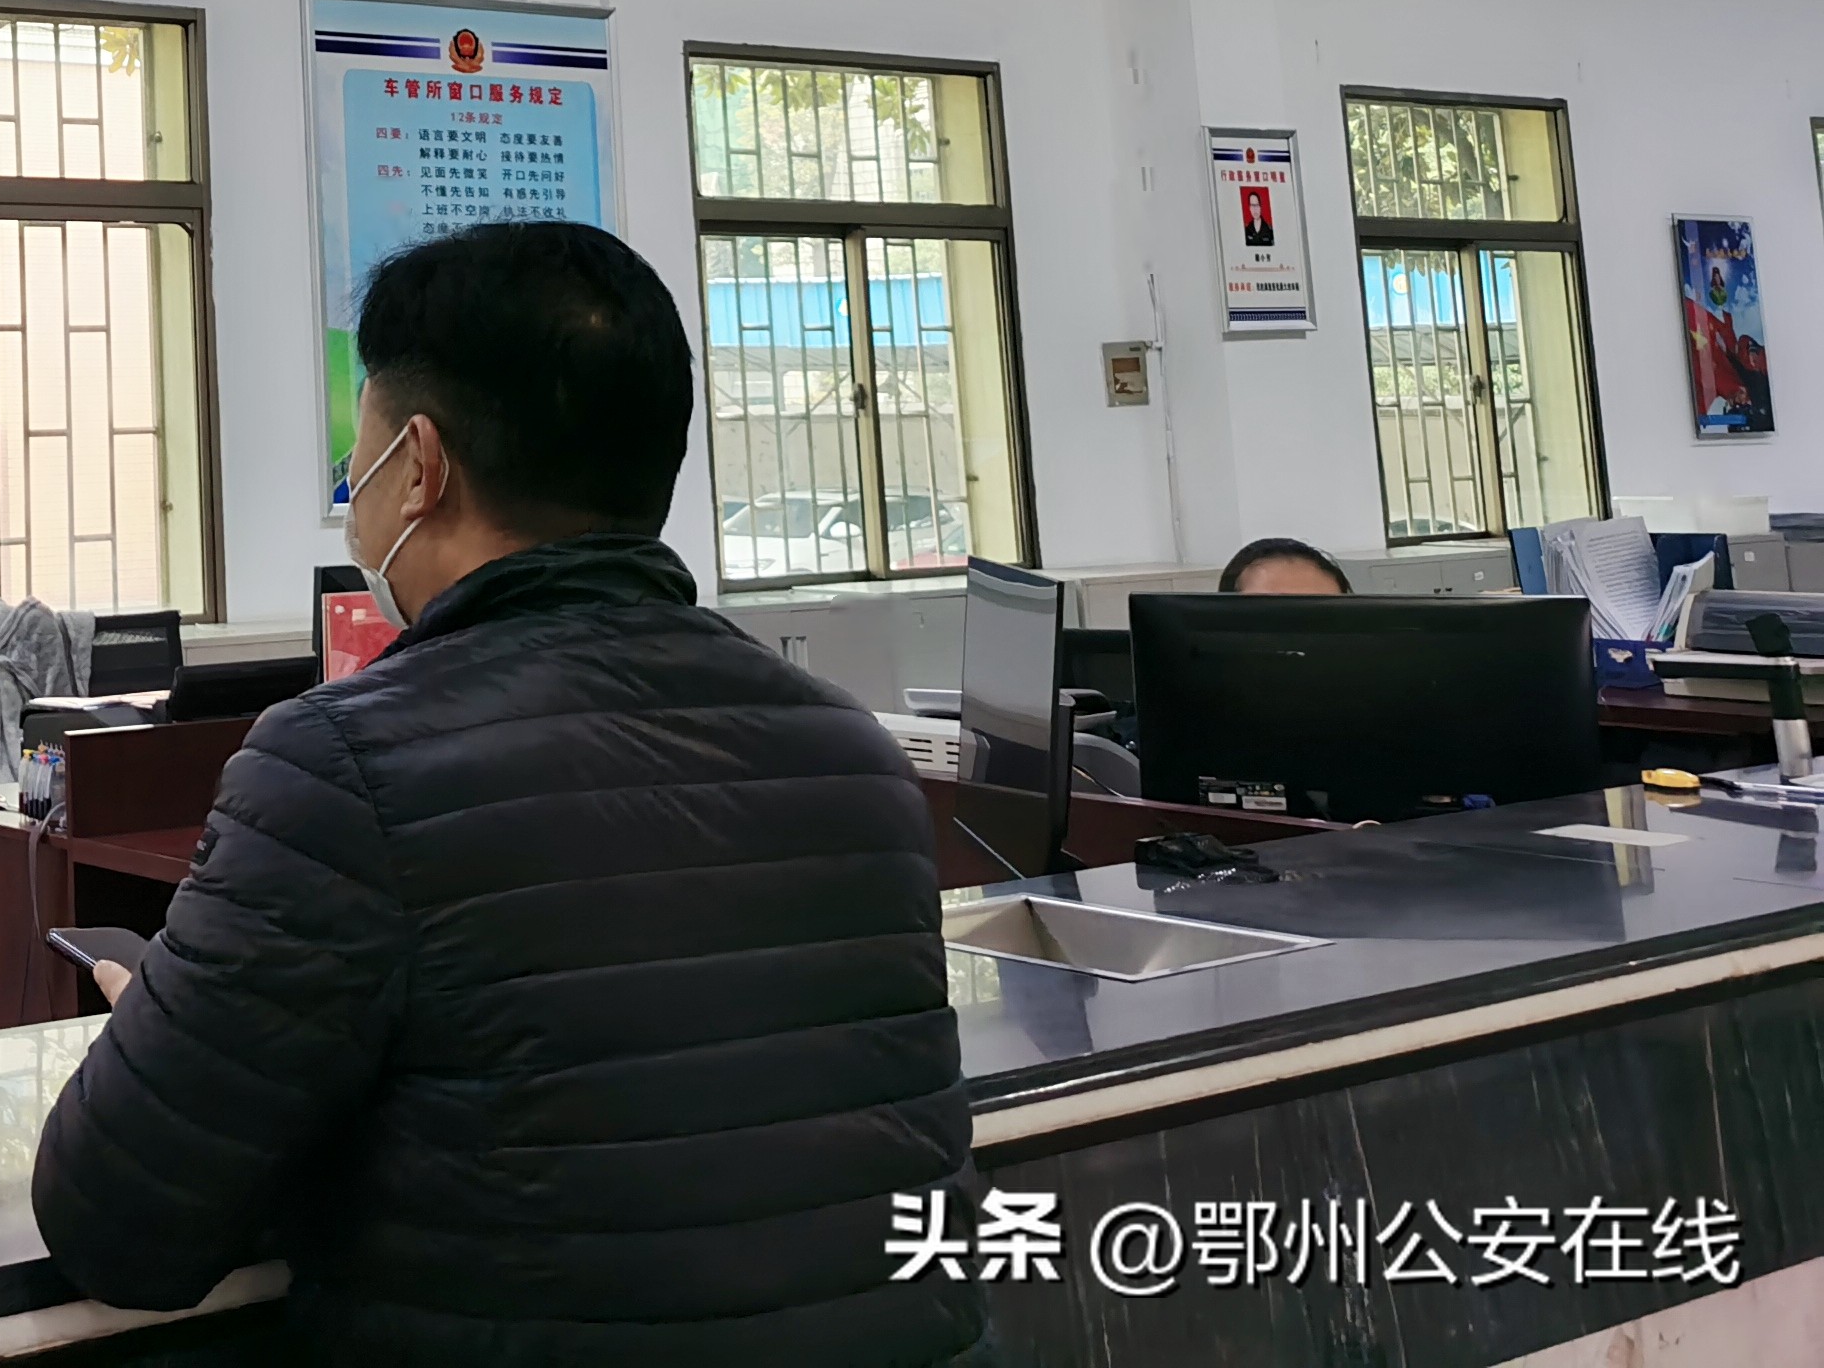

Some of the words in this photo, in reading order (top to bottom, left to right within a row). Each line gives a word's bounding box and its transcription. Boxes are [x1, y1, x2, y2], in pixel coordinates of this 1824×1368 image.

[384, 78, 563, 106] 车管所窗口服务规定
[451, 112, 504, 126] 12条规定
[419, 129, 487, 144] 语言要文明
[500, 132, 563, 147] 态度要友善
[419, 148, 488, 162] 解释要耐心
[500, 150, 564, 164] 接待要热情
[420, 166, 488, 180] 见面先微笑
[502, 169, 565, 182] 开口先问好
[421, 184, 489, 198] 不懂先告知
[503, 187, 566, 201] 有惑先引导
[422, 203, 490, 217] 上班不空岗
